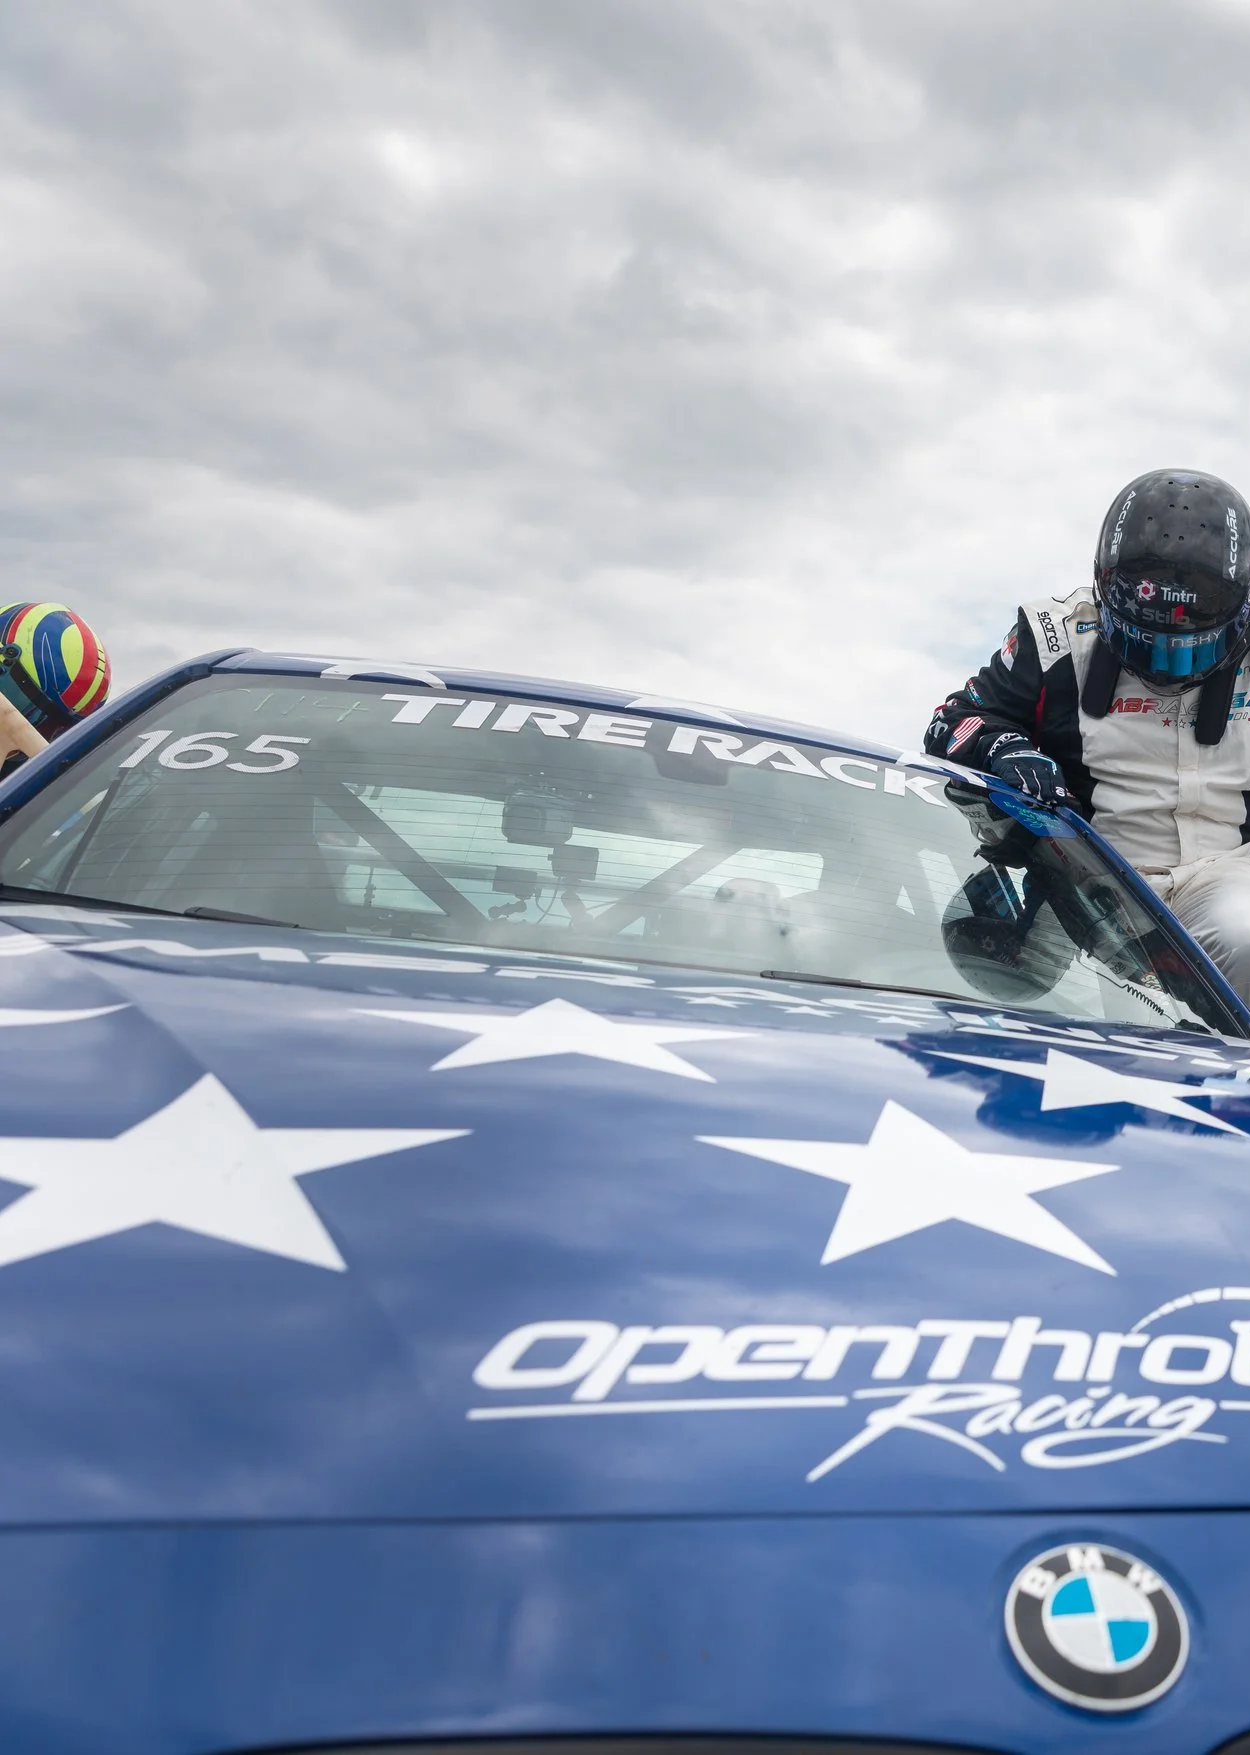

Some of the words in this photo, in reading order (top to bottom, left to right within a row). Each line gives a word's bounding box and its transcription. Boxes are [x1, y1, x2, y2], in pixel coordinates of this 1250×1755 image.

[1160, 586, 1197, 604] Tintri
[1037, 611, 1060, 653] sparco
[118, 729, 312, 774] 165
[381, 693, 654, 748] TIRE
[667, 725, 948, 808] RACK
[806, 1382, 1227, 1484] Racing
[1018, 1546, 1163, 1600] BMW
